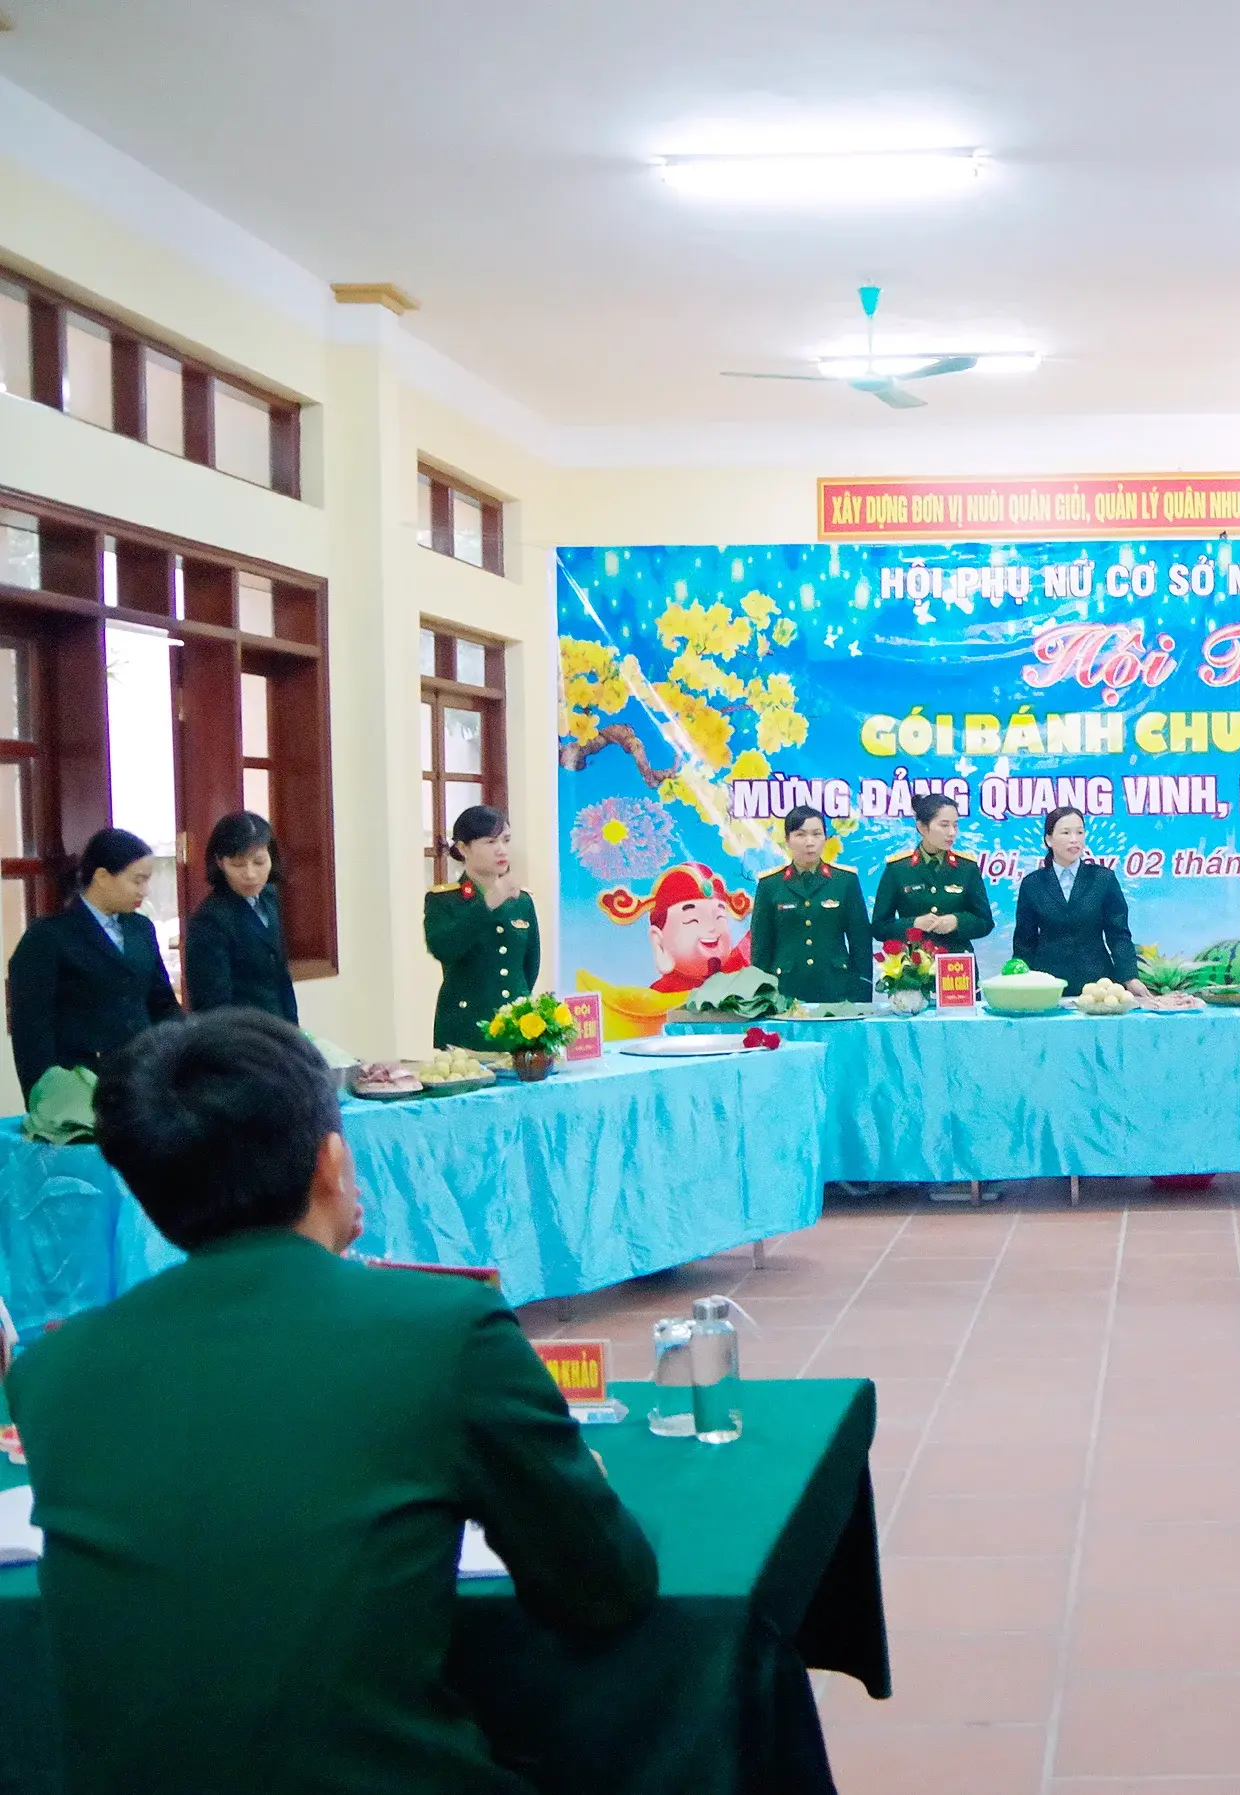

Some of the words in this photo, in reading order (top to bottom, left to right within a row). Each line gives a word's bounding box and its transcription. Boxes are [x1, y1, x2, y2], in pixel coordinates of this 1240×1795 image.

[832, 491, 862, 525] XÂY
[866, 493, 908, 529] DỰNG
[912, 492, 944, 524] ĐƠN
[948, 495, 963, 528] VỊ
[967, 489, 1004, 523] NUÔI
[1008, 489, 1050, 523] QUÂN
[1055, 483, 1091, 523] GIỎI,
[1094, 483, 1137, 522] QUẢN
[1141, 487, 1158, 520] LÝ
[1163, 486, 1206, 522] QUÂN
[880, 559, 943, 606] HỘI
[956, 564, 1031, 605] PHỤ
[1044, 557, 1096, 598] NỮ
[1105, 560, 1157, 598] CƠ
[1168, 555, 1215, 596] SỞ
[1022, 621, 1177, 706] Hội
[860, 705, 954, 756] GÓI
[964, 704, 1123, 755] BÁNH
[733, 772, 850, 819] MỪNG
[981, 775, 1113, 821] QUANG
[1122, 774, 1229, 819] VINH,
[979, 851, 1024, 883] ội,
[1126, 851, 1163, 876] 02
[562, 1350, 598, 1389] KHẢO
